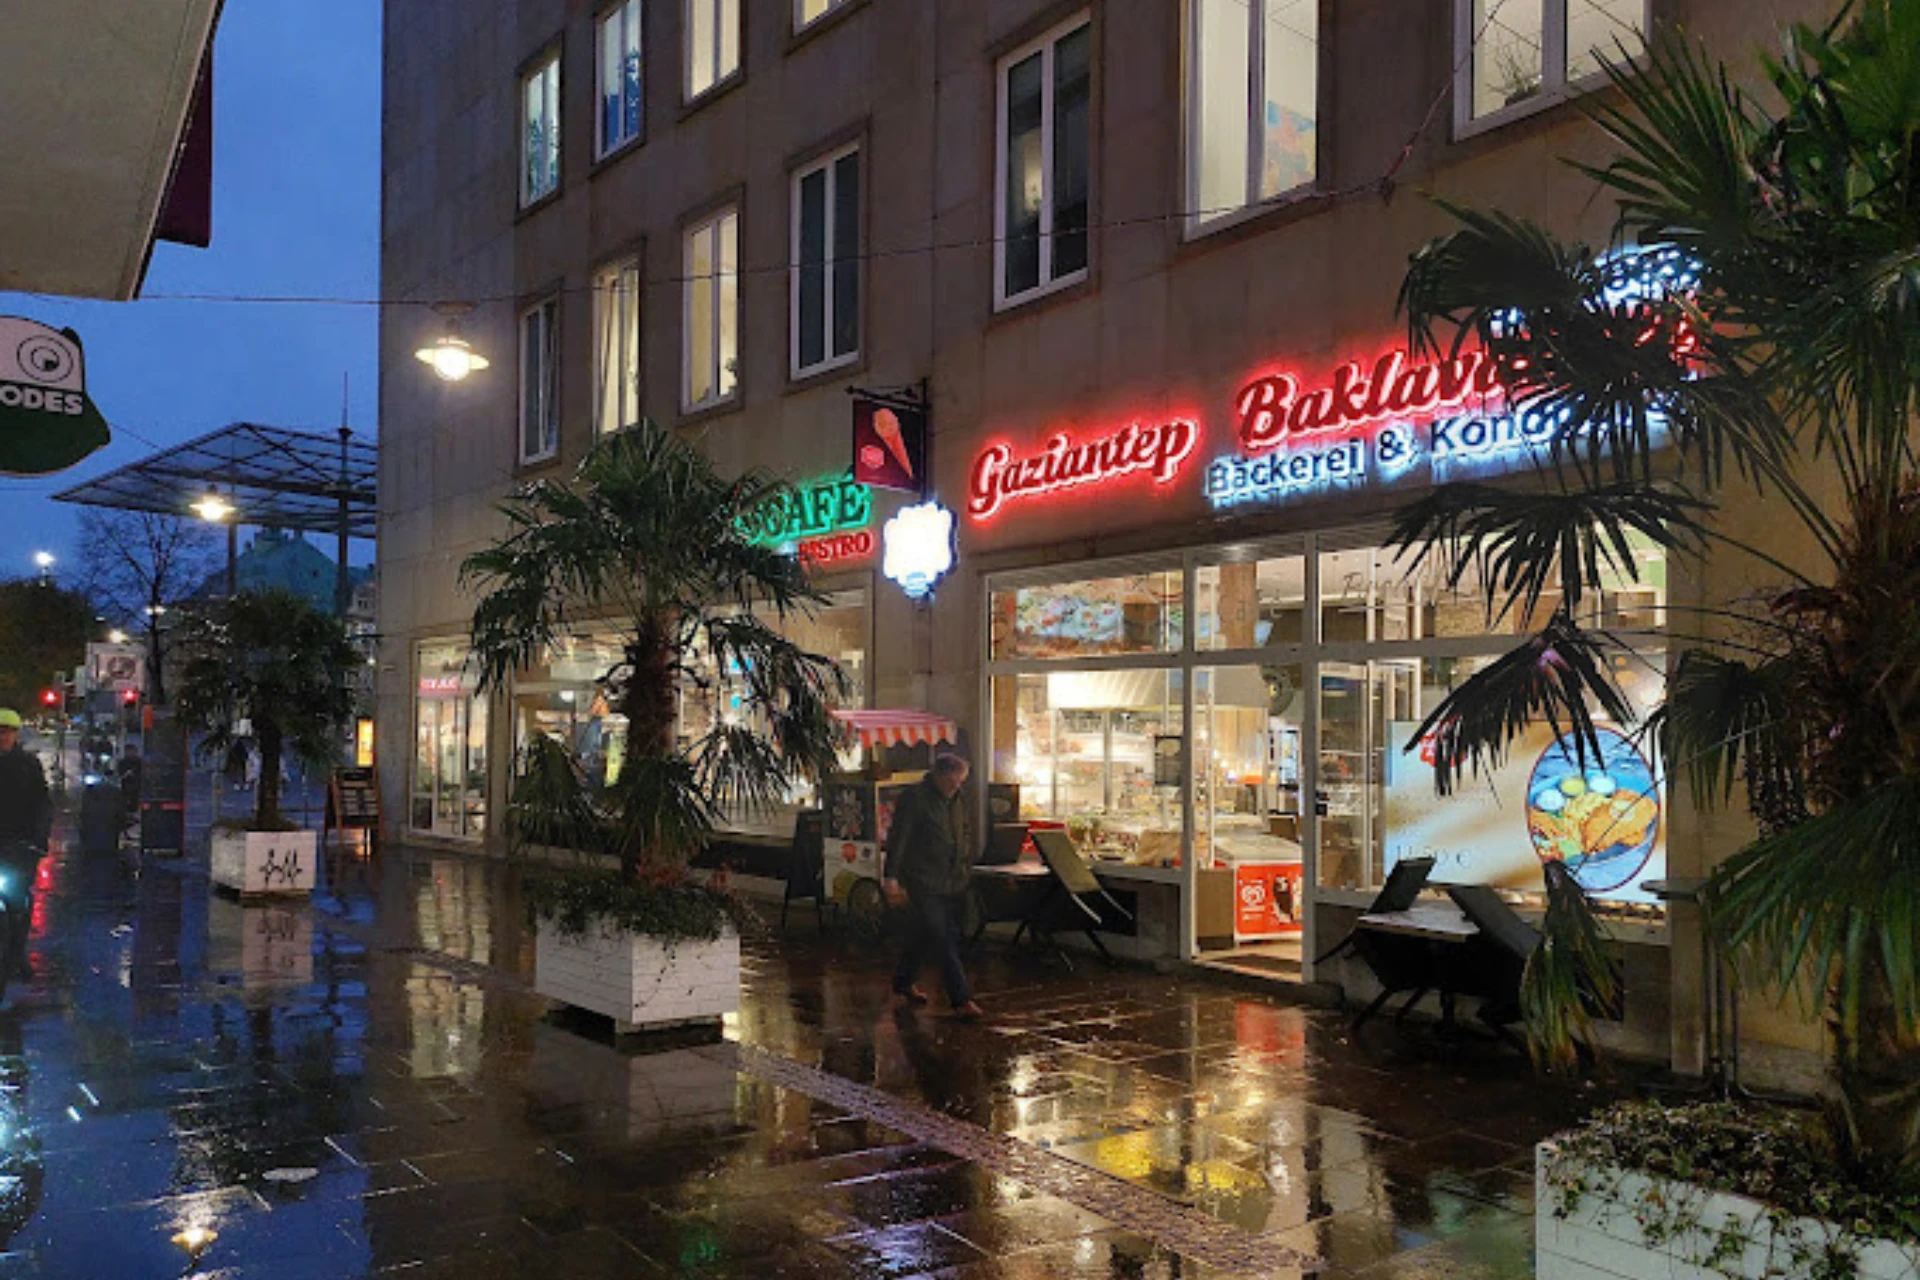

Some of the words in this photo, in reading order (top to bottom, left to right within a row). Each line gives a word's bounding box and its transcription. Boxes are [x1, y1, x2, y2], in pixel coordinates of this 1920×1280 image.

[968, 418, 1196, 518] Gaziantep
[1207, 437, 1363, 496] Bäckerei
[1378, 428, 1408, 466] &
